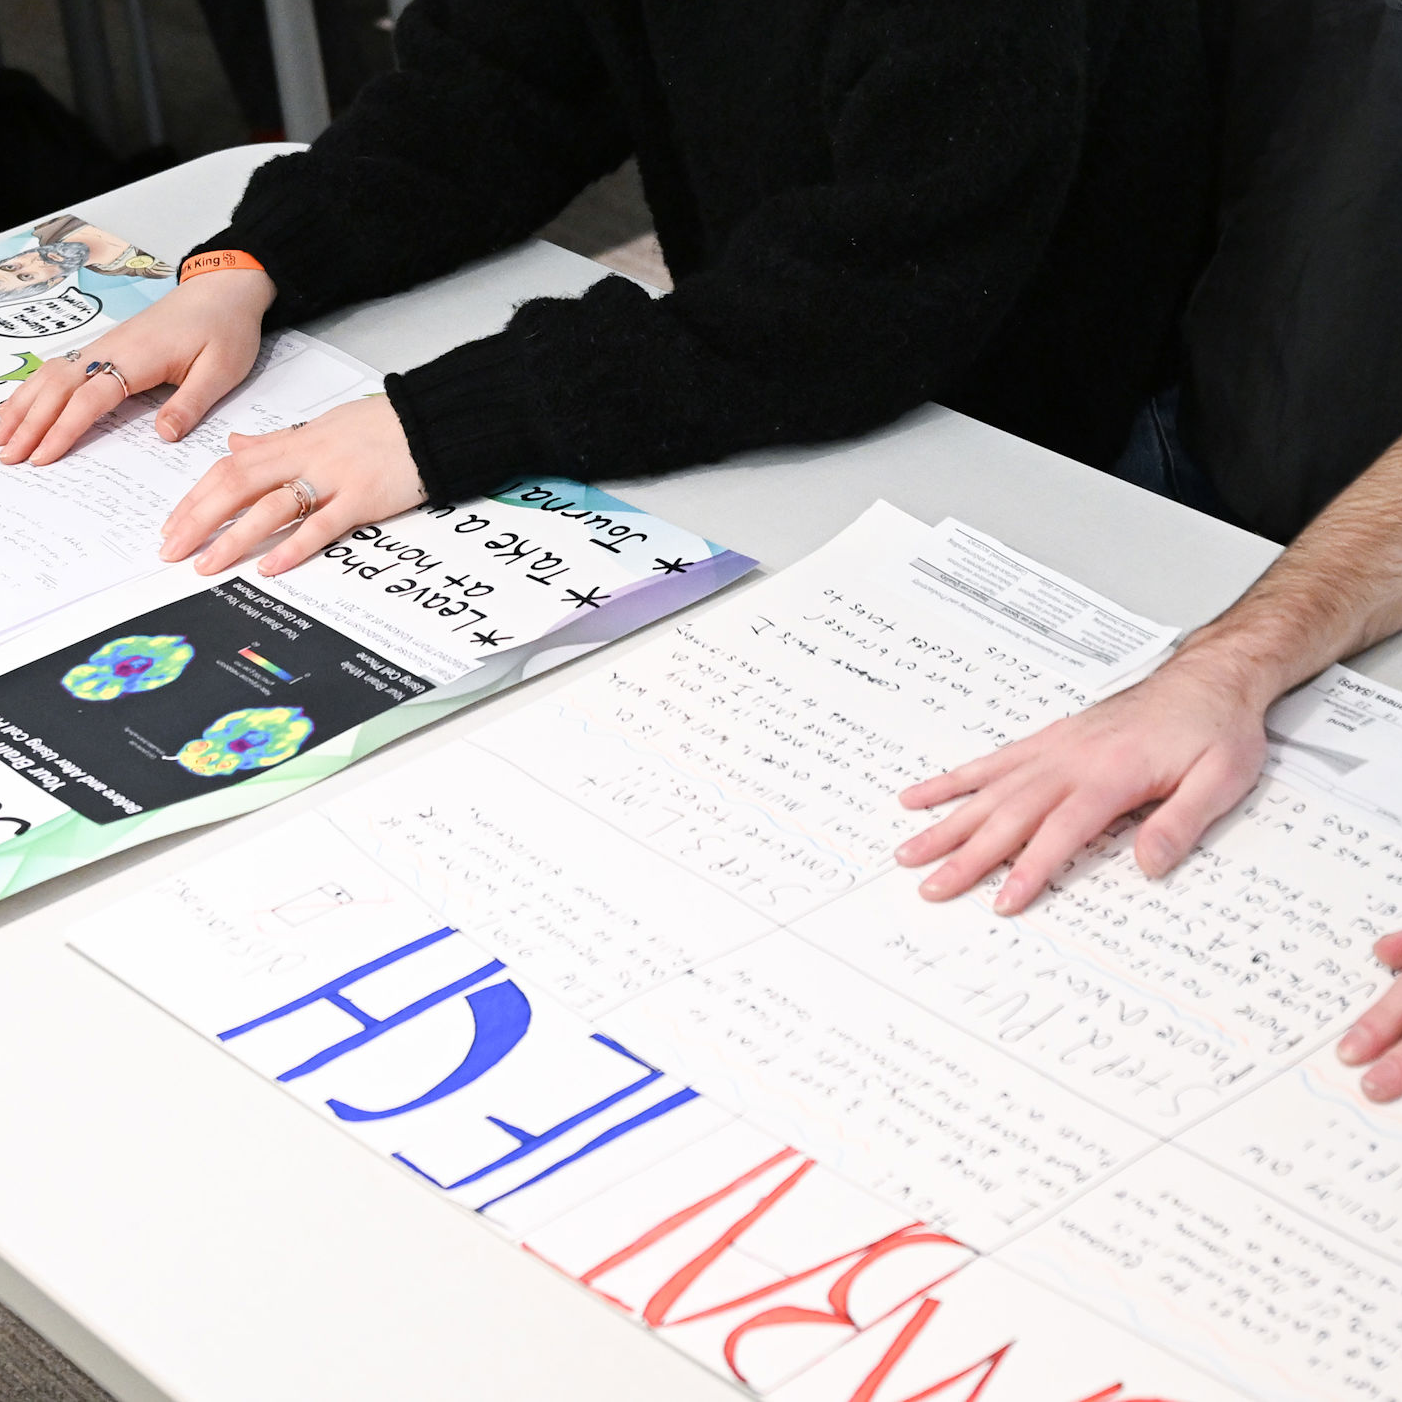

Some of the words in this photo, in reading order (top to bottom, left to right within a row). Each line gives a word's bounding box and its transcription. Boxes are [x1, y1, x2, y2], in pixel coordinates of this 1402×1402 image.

[194, 257, 221, 269] King
[455, 514, 490, 533] a
[346, 520, 442, 574] home
[310, 535, 400, 579] pho
[485, 533, 570, 585] Take
[205, 584, 228, 597] Are
[233, 583, 260, 601] Phone
[443, 575, 494, 604] at
[224, 594, 245, 607] You
[253, 595, 275, 608] Cell
[385, 573, 487, 631] Leave
[238, 603, 266, 619] When
[270, 605, 296, 621] Using
[255, 616, 283, 630] Brain
[290, 618, 312, 630] Not
[274, 626, 299, 641] Your
[341, 661, 370, 678] While
[356, 652, 385, 670] Phone
[377, 666, 407, 680] Cell
[358, 674, 388, 691] Brain
[394, 675, 432, 695] Using
[1338, 675, 1375, 697] (SAPS)
[380, 686, 405, 701] Your
[0, 723, 29, 742] Cell
[25, 738, 59, 762] Using
[52, 756, 87, 781] After
[27, 767, 66, 792] Your
[76, 774, 107, 793] and
[102, 788, 143, 818] Before
